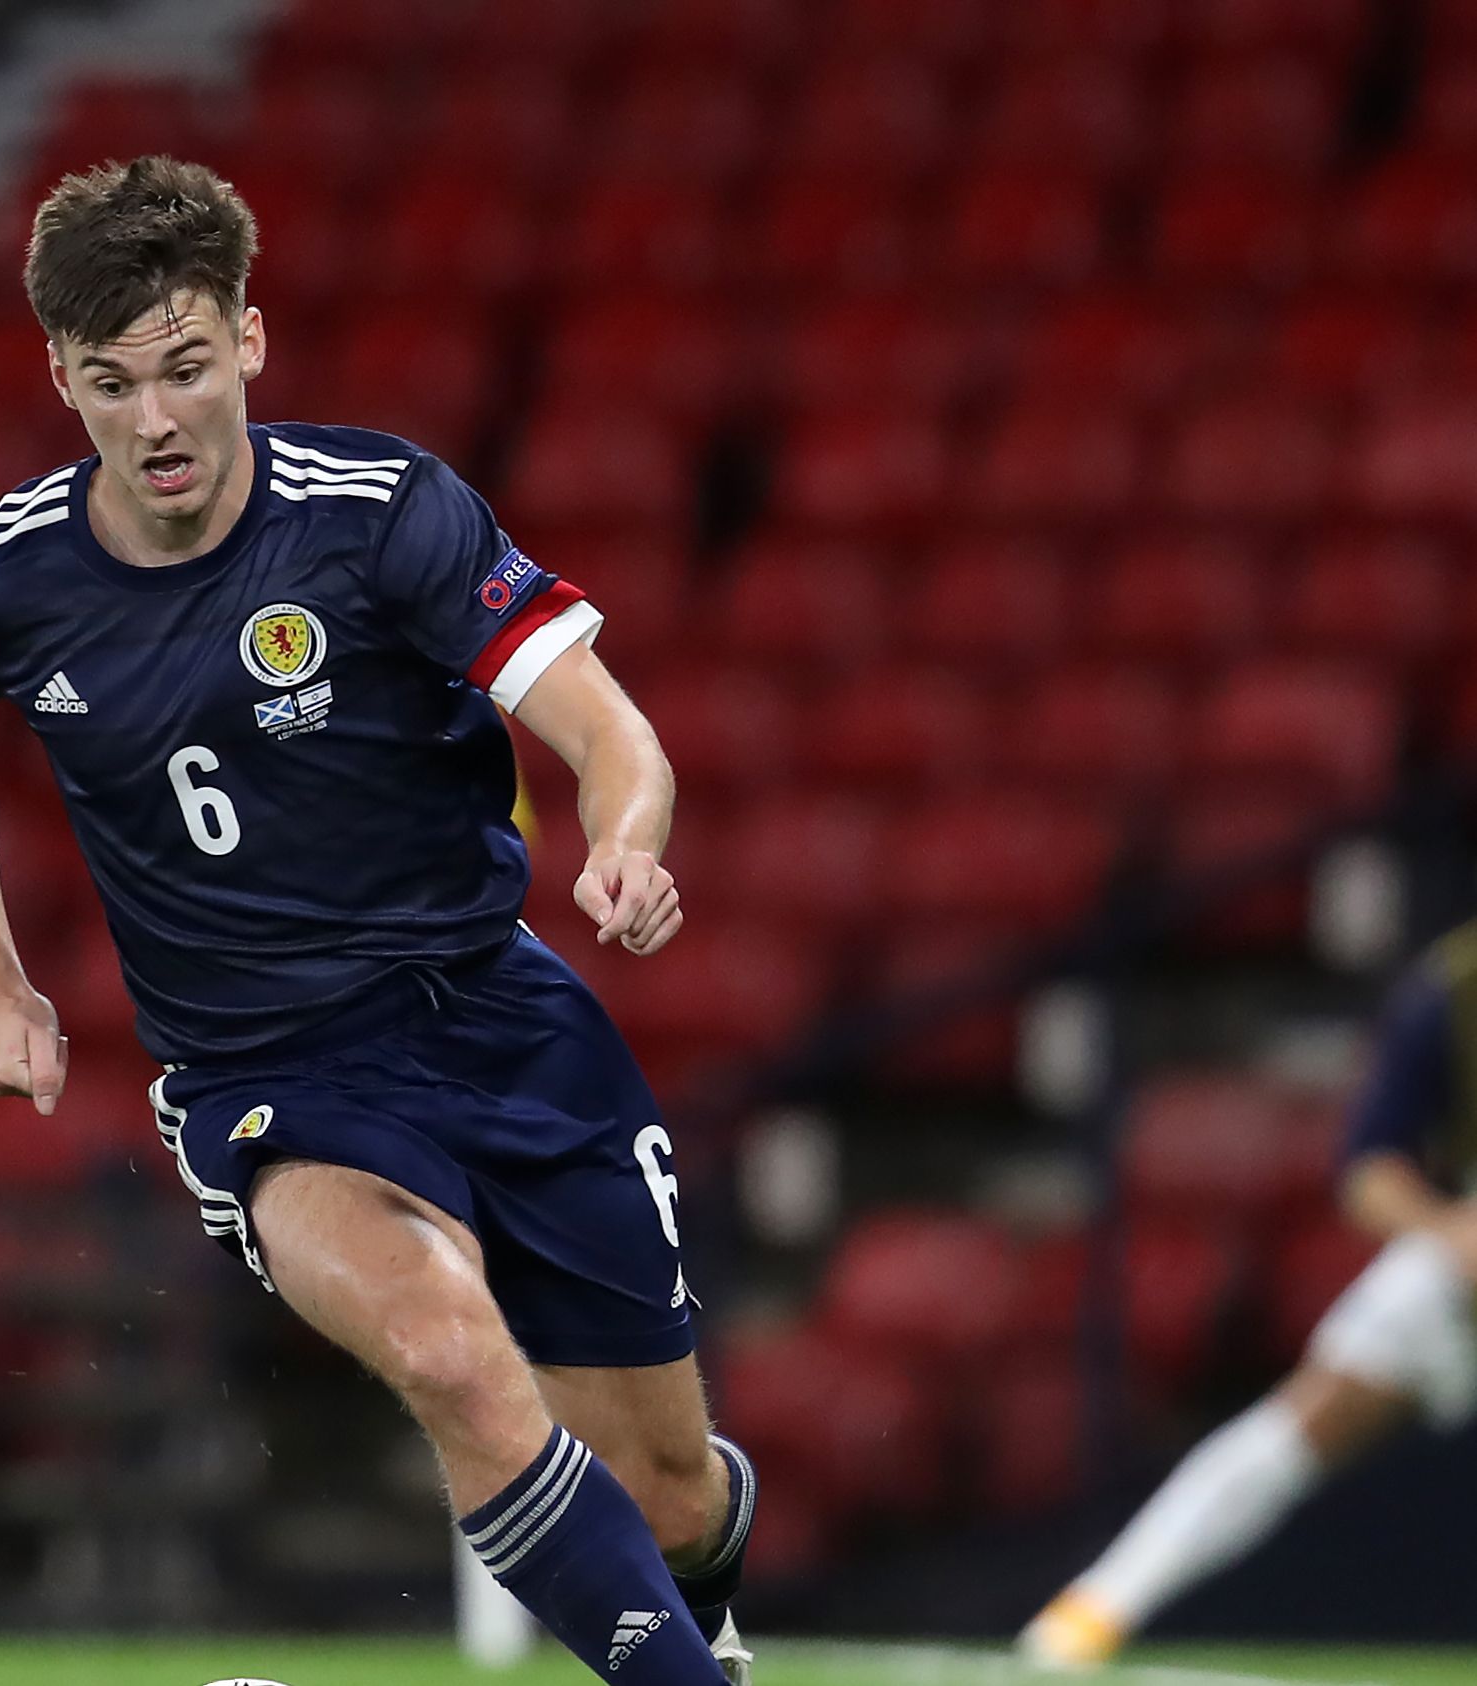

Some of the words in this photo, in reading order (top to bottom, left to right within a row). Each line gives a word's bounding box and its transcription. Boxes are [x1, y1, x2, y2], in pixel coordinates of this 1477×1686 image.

[256, 606, 299, 619] SCOTLAND
[34, 697, 89, 714] adidas
[167, 745, 241, 855] 6
[633, 1125, 679, 1248] 6
[609, 1610, 671, 1671] adidas
